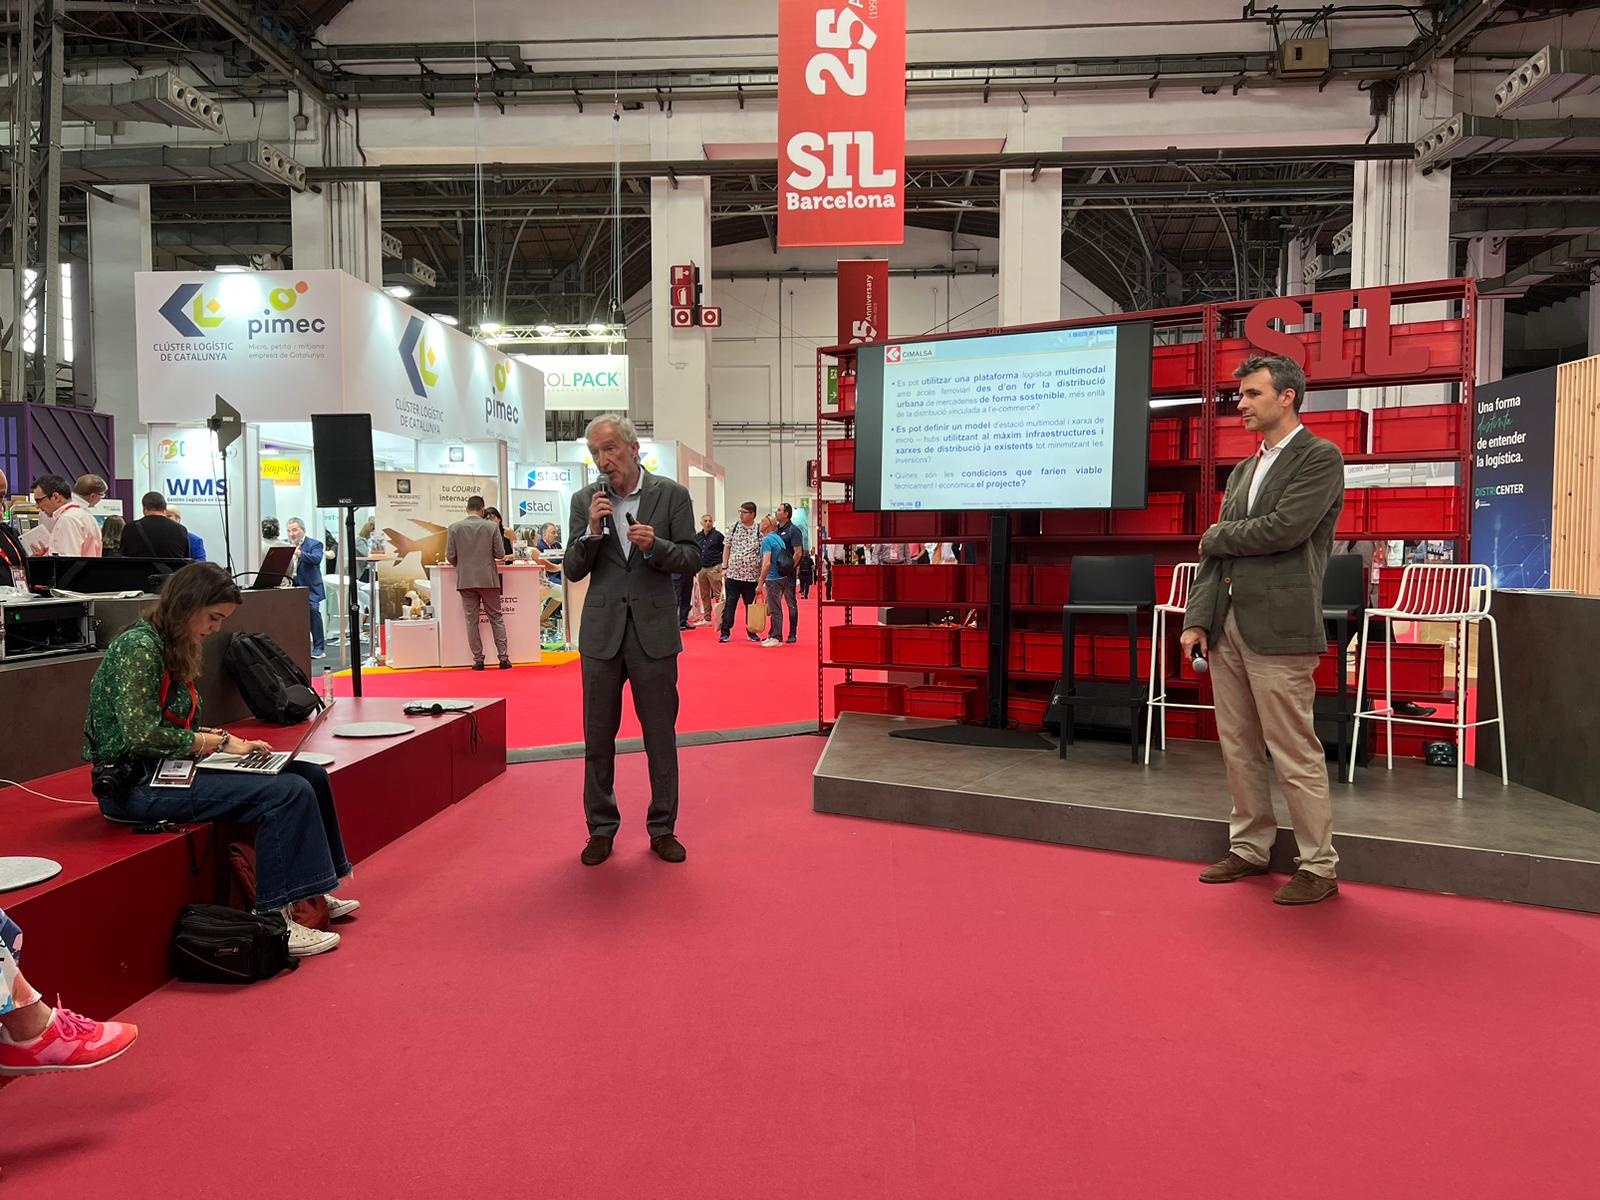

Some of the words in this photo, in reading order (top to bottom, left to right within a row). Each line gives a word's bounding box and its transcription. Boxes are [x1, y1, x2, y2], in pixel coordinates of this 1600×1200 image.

[805, 7, 877, 96] 25
[786, 131, 897, 190] SIL
[786, 191, 896, 210] Barcelona
[865, 274, 874, 322] Anniversary
[248, 309, 326, 340] pimec
[1244, 288, 1430, 381] SIL
[153, 341, 191, 351] CLÚSTER
[194, 340, 233, 351] LOGÍSTIC
[160, 353, 172, 361] DE
[174, 352, 227, 361] CATALUNYA
[902, 350, 932, 358] CIMALSA
[544, 372, 618, 387] OLPACK
[921, 377, 951, 385] utilitzar
[973, 372, 1018, 382] plataforma
[1055, 365, 1106, 375] multimodal
[1057, 376, 1105, 387] distribució
[485, 386, 519, 425] pimec
[896, 400, 924, 408] urbana
[992, 394, 1017, 402] forma
[1478, 401, 1494, 414] Una
[1495, 396, 1521, 410] forma
[395, 398, 419, 416] CLÚSTER
[420, 406, 444, 422] LOGÍSTIC
[913, 408, 947, 416] distribució
[948, 407, 980, 415] vinculada
[400, 415, 409, 427] DE
[409, 416, 441, 434] CATALUNYA
[908, 425, 921, 434] pot
[923, 423, 949, 432] definir
[964, 421, 990, 430] model
[1026, 418, 1065, 427] multimodal
[1094, 416, 1104, 424] de
[943, 433, 978, 441] utilitzant
[1025, 428, 1096, 438] infraestructures
[1477, 437, 1487, 450] de
[1488, 431, 1526, 448] entender
[937, 444, 980, 453] distribució
[983, 444, 991, 453] ja
[994, 442, 1033, 450] existents
[1047, 440, 1090, 448] minimitzant
[1476, 455, 1484, 468] la
[1485, 451, 1523, 468] logística.
[263, 463, 300, 474] Bags&go
[537, 469, 571, 481] staci
[961, 469, 1007, 478] condicions
[1016, 469, 1032, 477] que
[1041, 467, 1066, 475] farien
[1075, 466, 1103, 474] viable
[166, 479, 227, 496] WMS
[451, 485, 481, 493] COURIER
[976, 480, 984, 488] el
[986, 478, 1026, 489] projecte?
[1475, 484, 1524, 497] DISTRICENTER
[527, 501, 553, 511] staci
